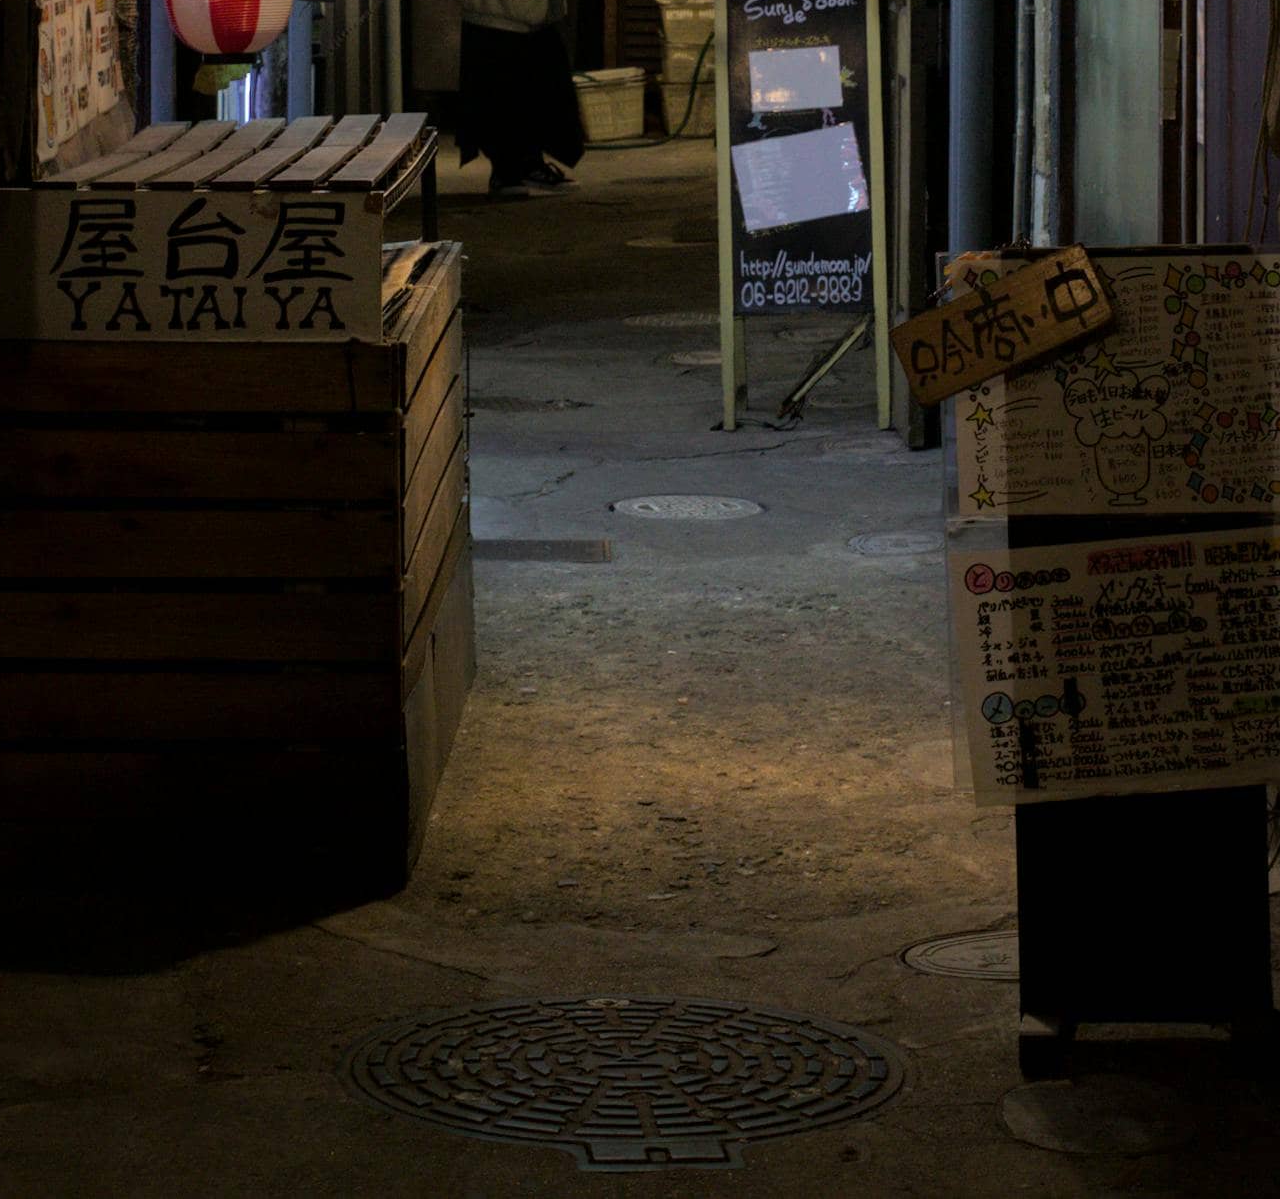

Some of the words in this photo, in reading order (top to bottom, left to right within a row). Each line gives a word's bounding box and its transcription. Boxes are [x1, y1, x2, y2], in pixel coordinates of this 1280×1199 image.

[782, 3, 808, 26] de
[49, 197, 354, 285] 屋台屋
